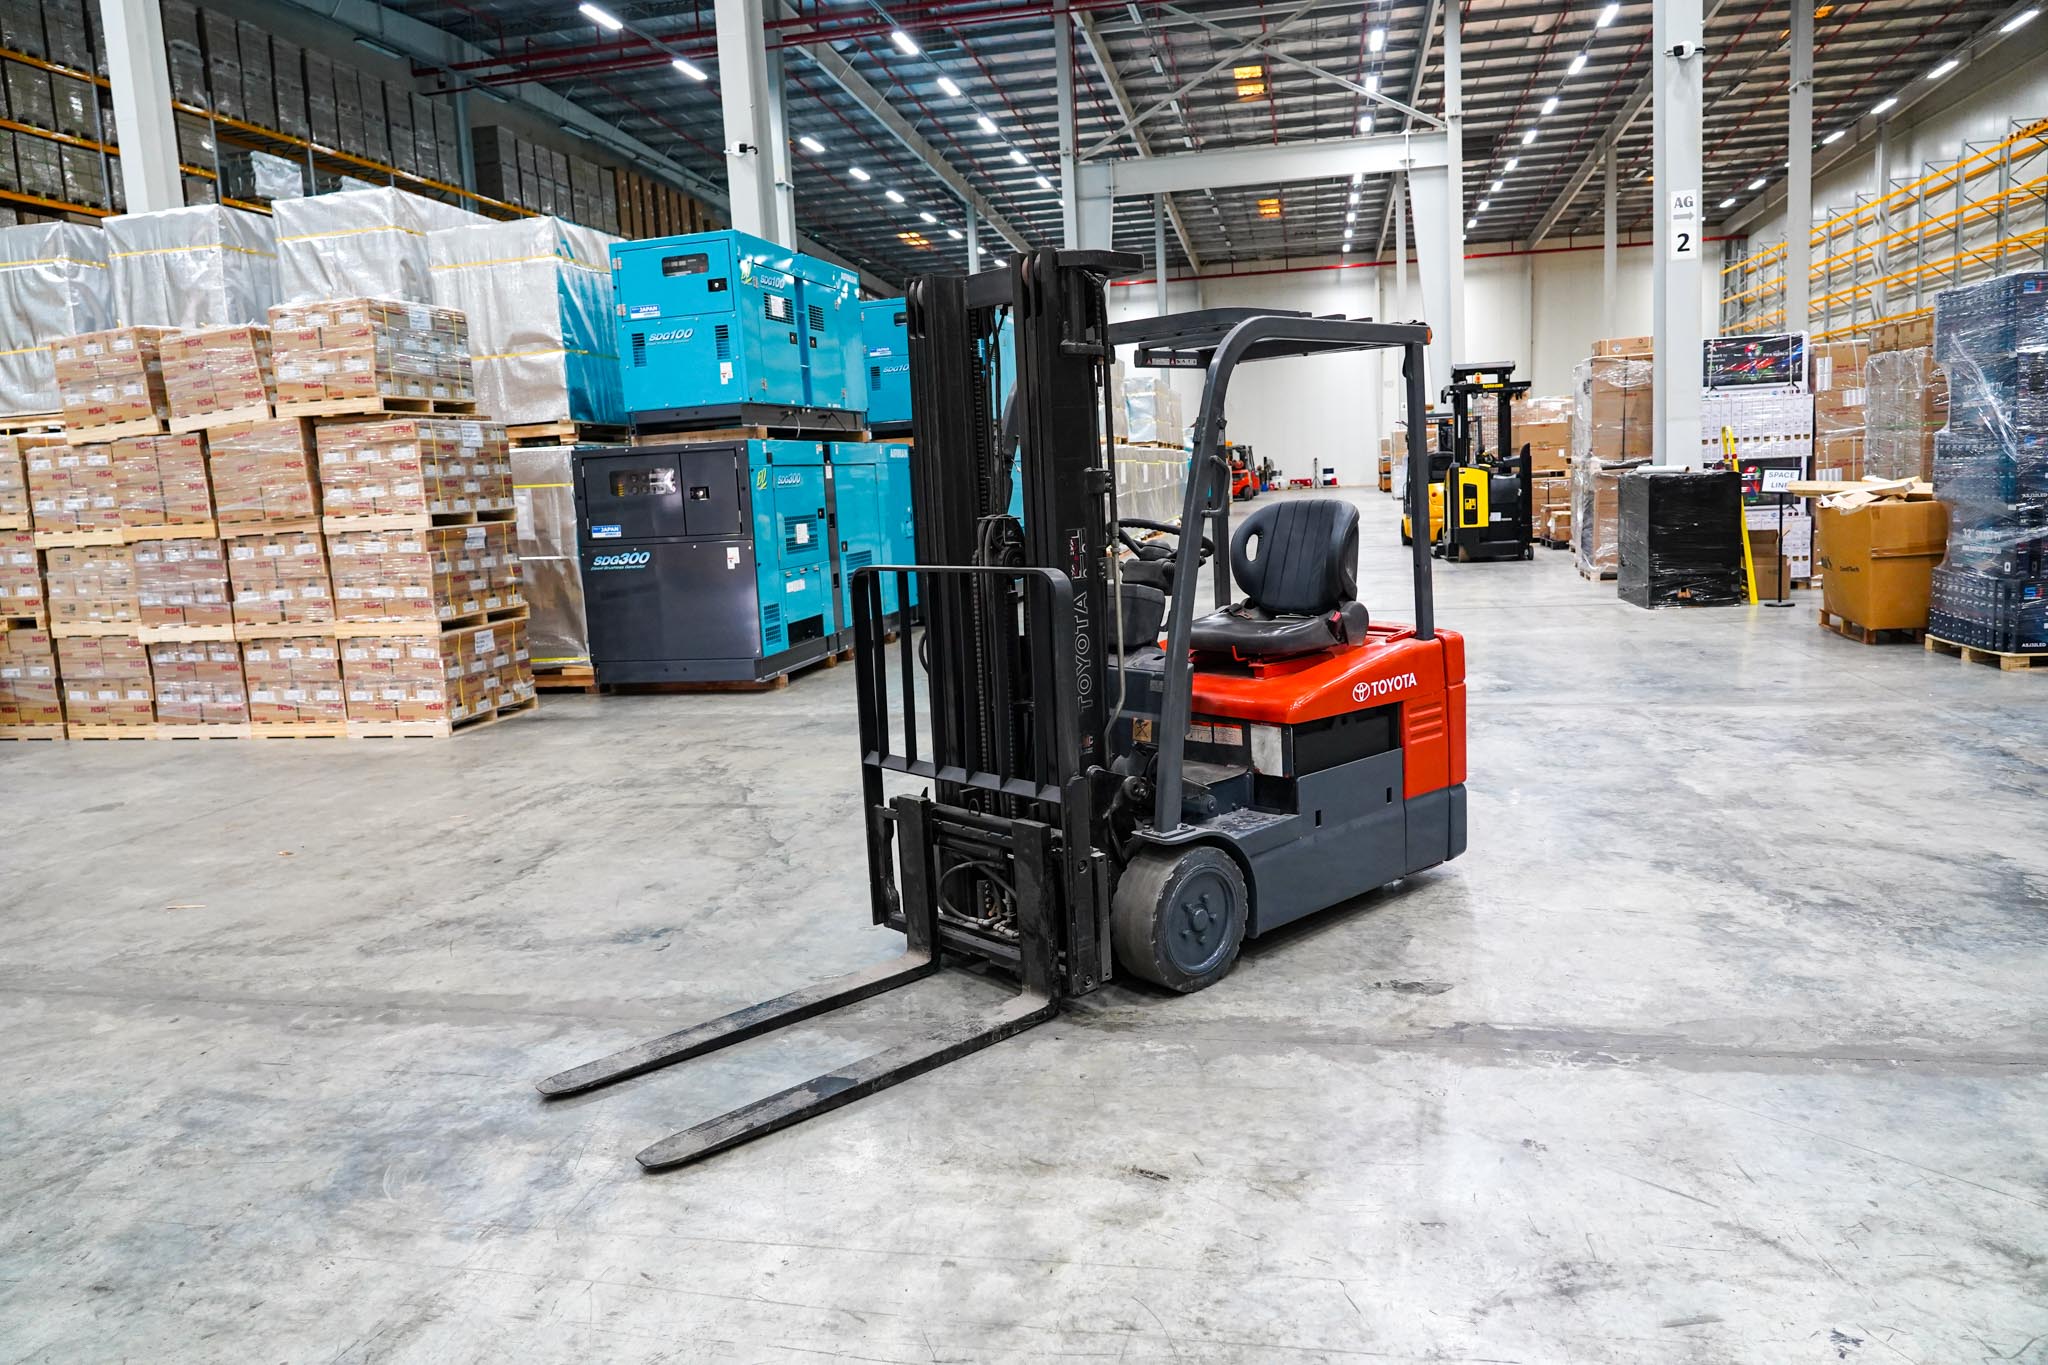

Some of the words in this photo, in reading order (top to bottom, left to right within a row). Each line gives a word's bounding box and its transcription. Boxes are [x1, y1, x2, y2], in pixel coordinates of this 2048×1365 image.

[1674, 196, 1694, 209] AG
[1677, 233, 1690, 252] 2
[760, 275, 784, 288] SDG100
[230, 332, 247, 341] NSK
[299, 332, 316, 341] NSK
[649, 328, 693, 341] SDG100
[185, 339, 203, 347] NSK
[245, 390, 263, 399] NSK
[197, 398, 215, 407] NSK
[88, 407, 104, 415] NSK
[181, 438, 197, 446] NSK
[778, 472, 801, 484] SDG300
[593, 552, 650, 566] SDG300
[1074, 591, 1093, 712] TOYOTA
[1371, 672, 1417, 697] TOYOTA
